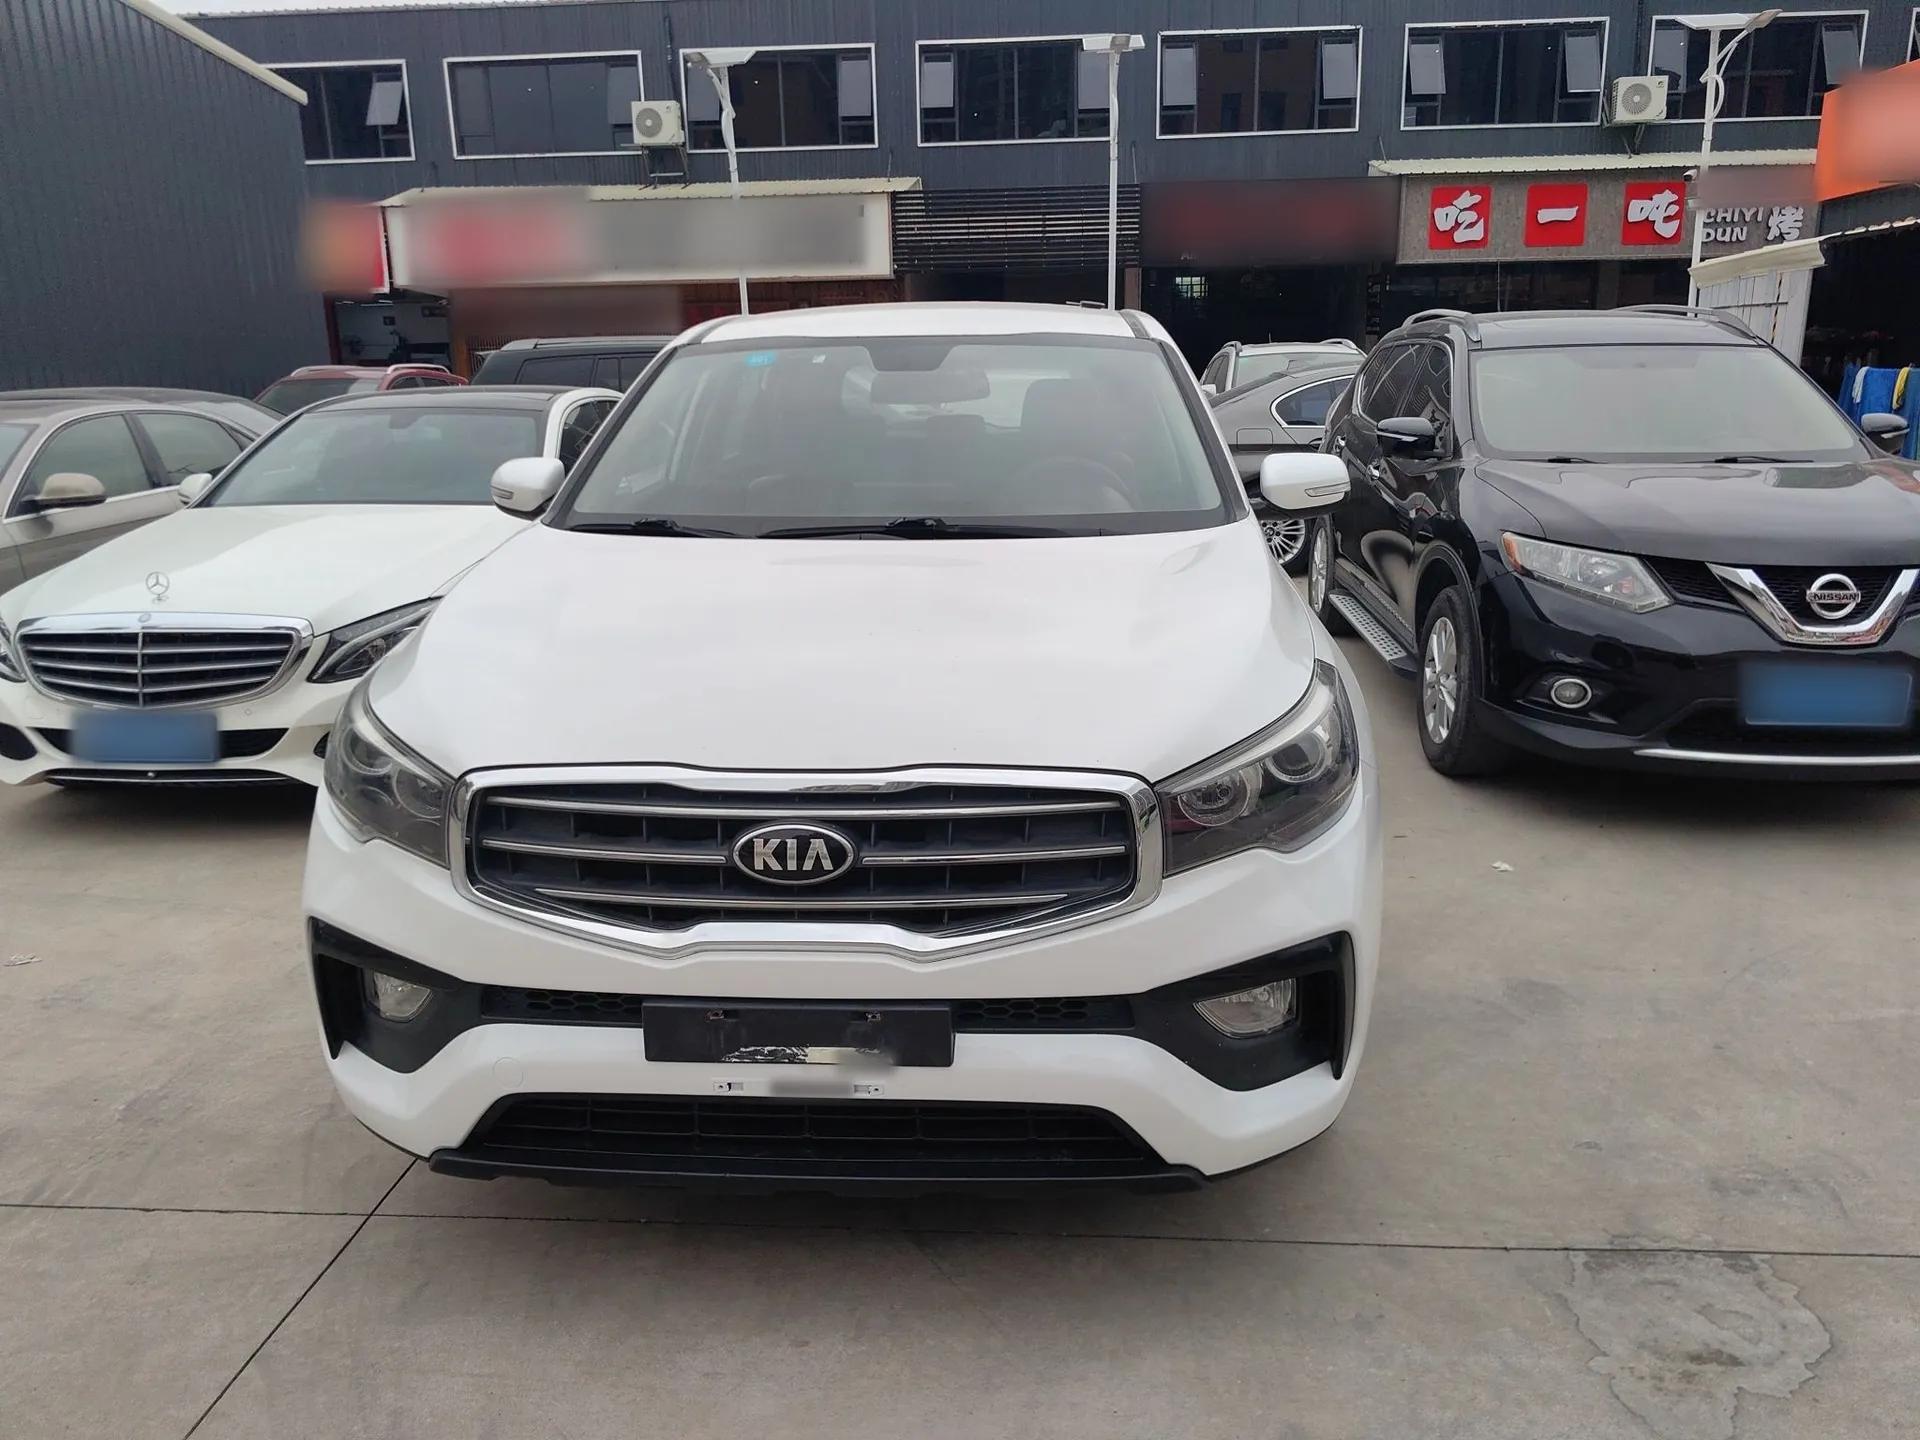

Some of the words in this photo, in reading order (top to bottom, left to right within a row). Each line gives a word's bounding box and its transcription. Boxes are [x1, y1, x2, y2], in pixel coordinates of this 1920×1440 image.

[1433, 190, 1681, 243] 吃一吨
[1702, 207, 1764, 223] CHIYI
[1767, 206, 1804, 241] 烤
[1701, 226, 1748, 242] DUN
[1812, 592, 1858, 601] NISSAN
[752, 838, 834, 871] KIA
